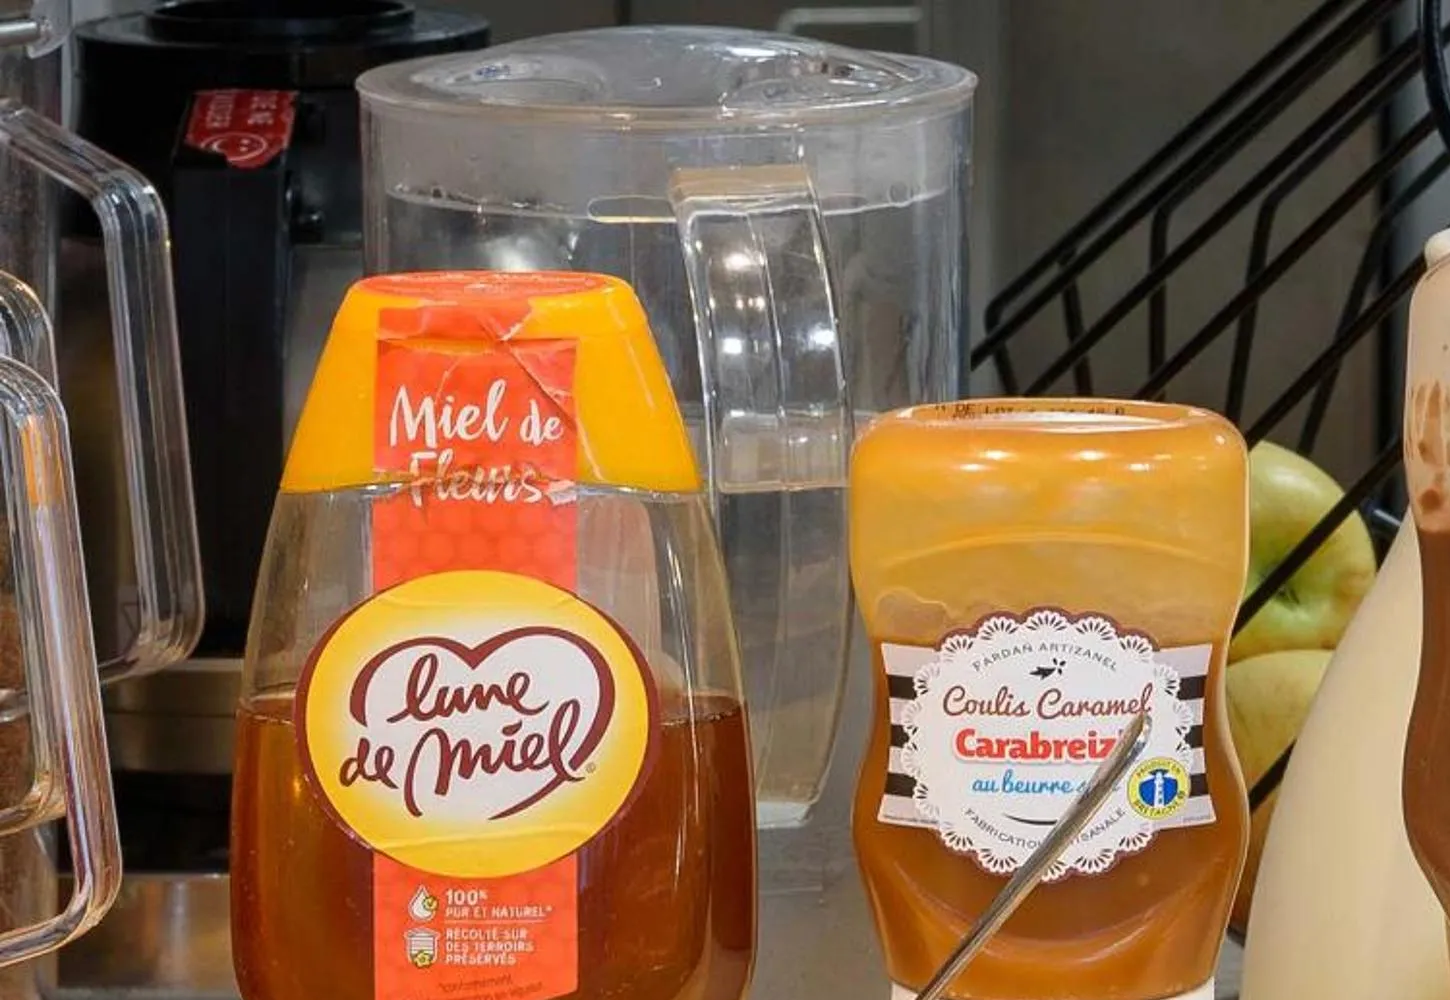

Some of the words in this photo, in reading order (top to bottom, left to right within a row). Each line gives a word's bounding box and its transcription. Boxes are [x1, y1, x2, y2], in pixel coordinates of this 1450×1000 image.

[390, 378, 509, 449] Miel
[519, 398, 564, 447] de
[408, 448, 544, 508] Fleurs
[386, 652, 548, 723] lune
[942, 685, 1032, 718] Coulis
[1036, 682, 1154, 720] Caramel
[338, 737, 400, 790] de
[955, 728, 1126, 760] Carabreiz
[971, 779, 1001, 794] au
[1001, 768, 1074, 795] beurre
[965, 807, 1044, 850] FABRICATIO
[446, 906, 470, 917] PUR
[473, 906, 487, 917] ET
[446, 940, 469, 953] DES
